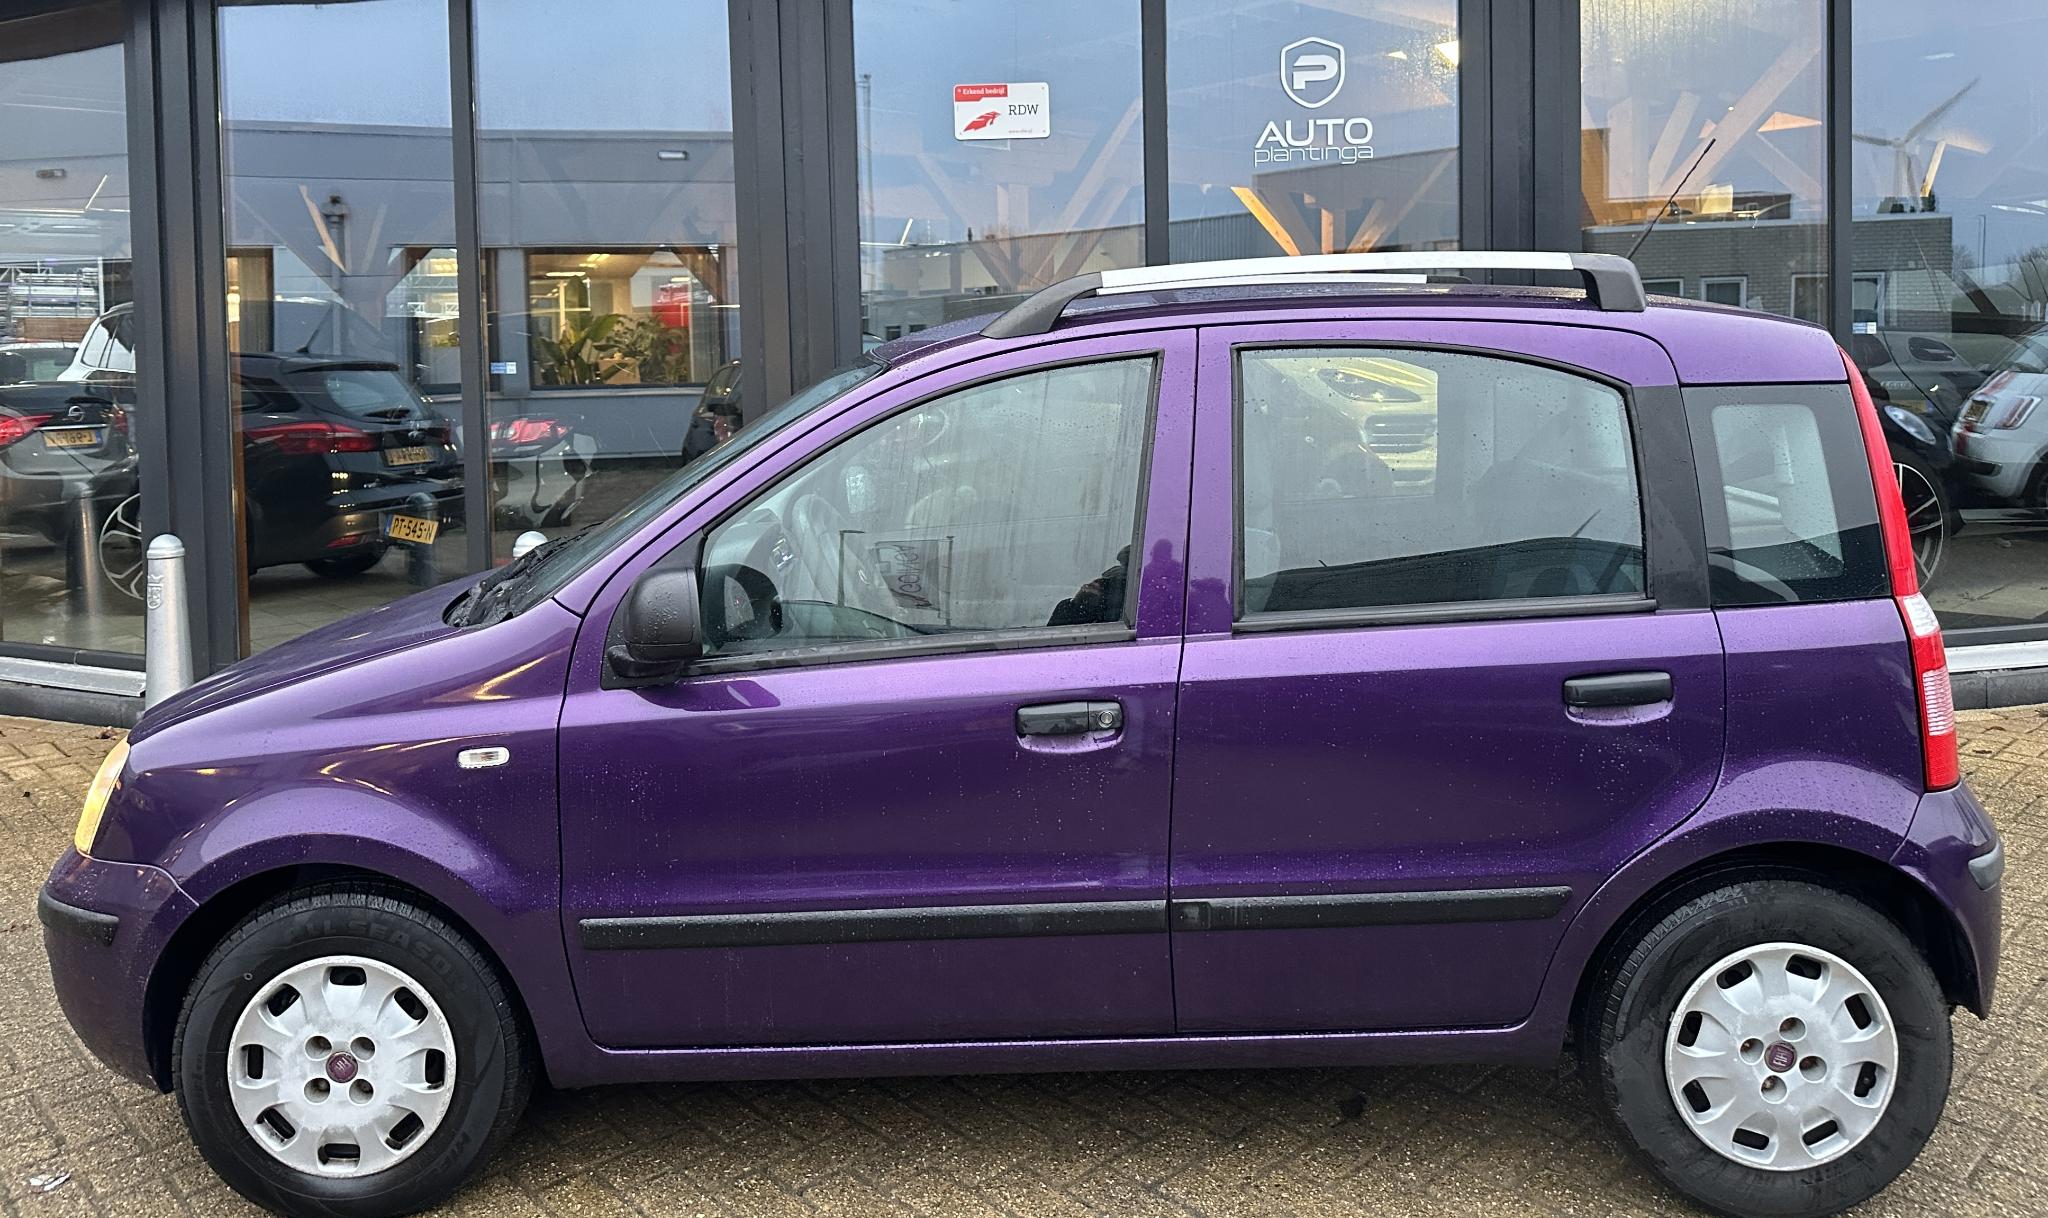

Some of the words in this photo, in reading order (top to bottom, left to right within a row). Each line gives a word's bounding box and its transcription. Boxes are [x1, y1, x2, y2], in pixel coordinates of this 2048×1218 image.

[1008, 104, 1039, 116] RDW
[1254, 117, 1374, 149] AUTO
[1254, 145, 1375, 168] plantinga
[391, 517, 435, 541] PT-545-N
